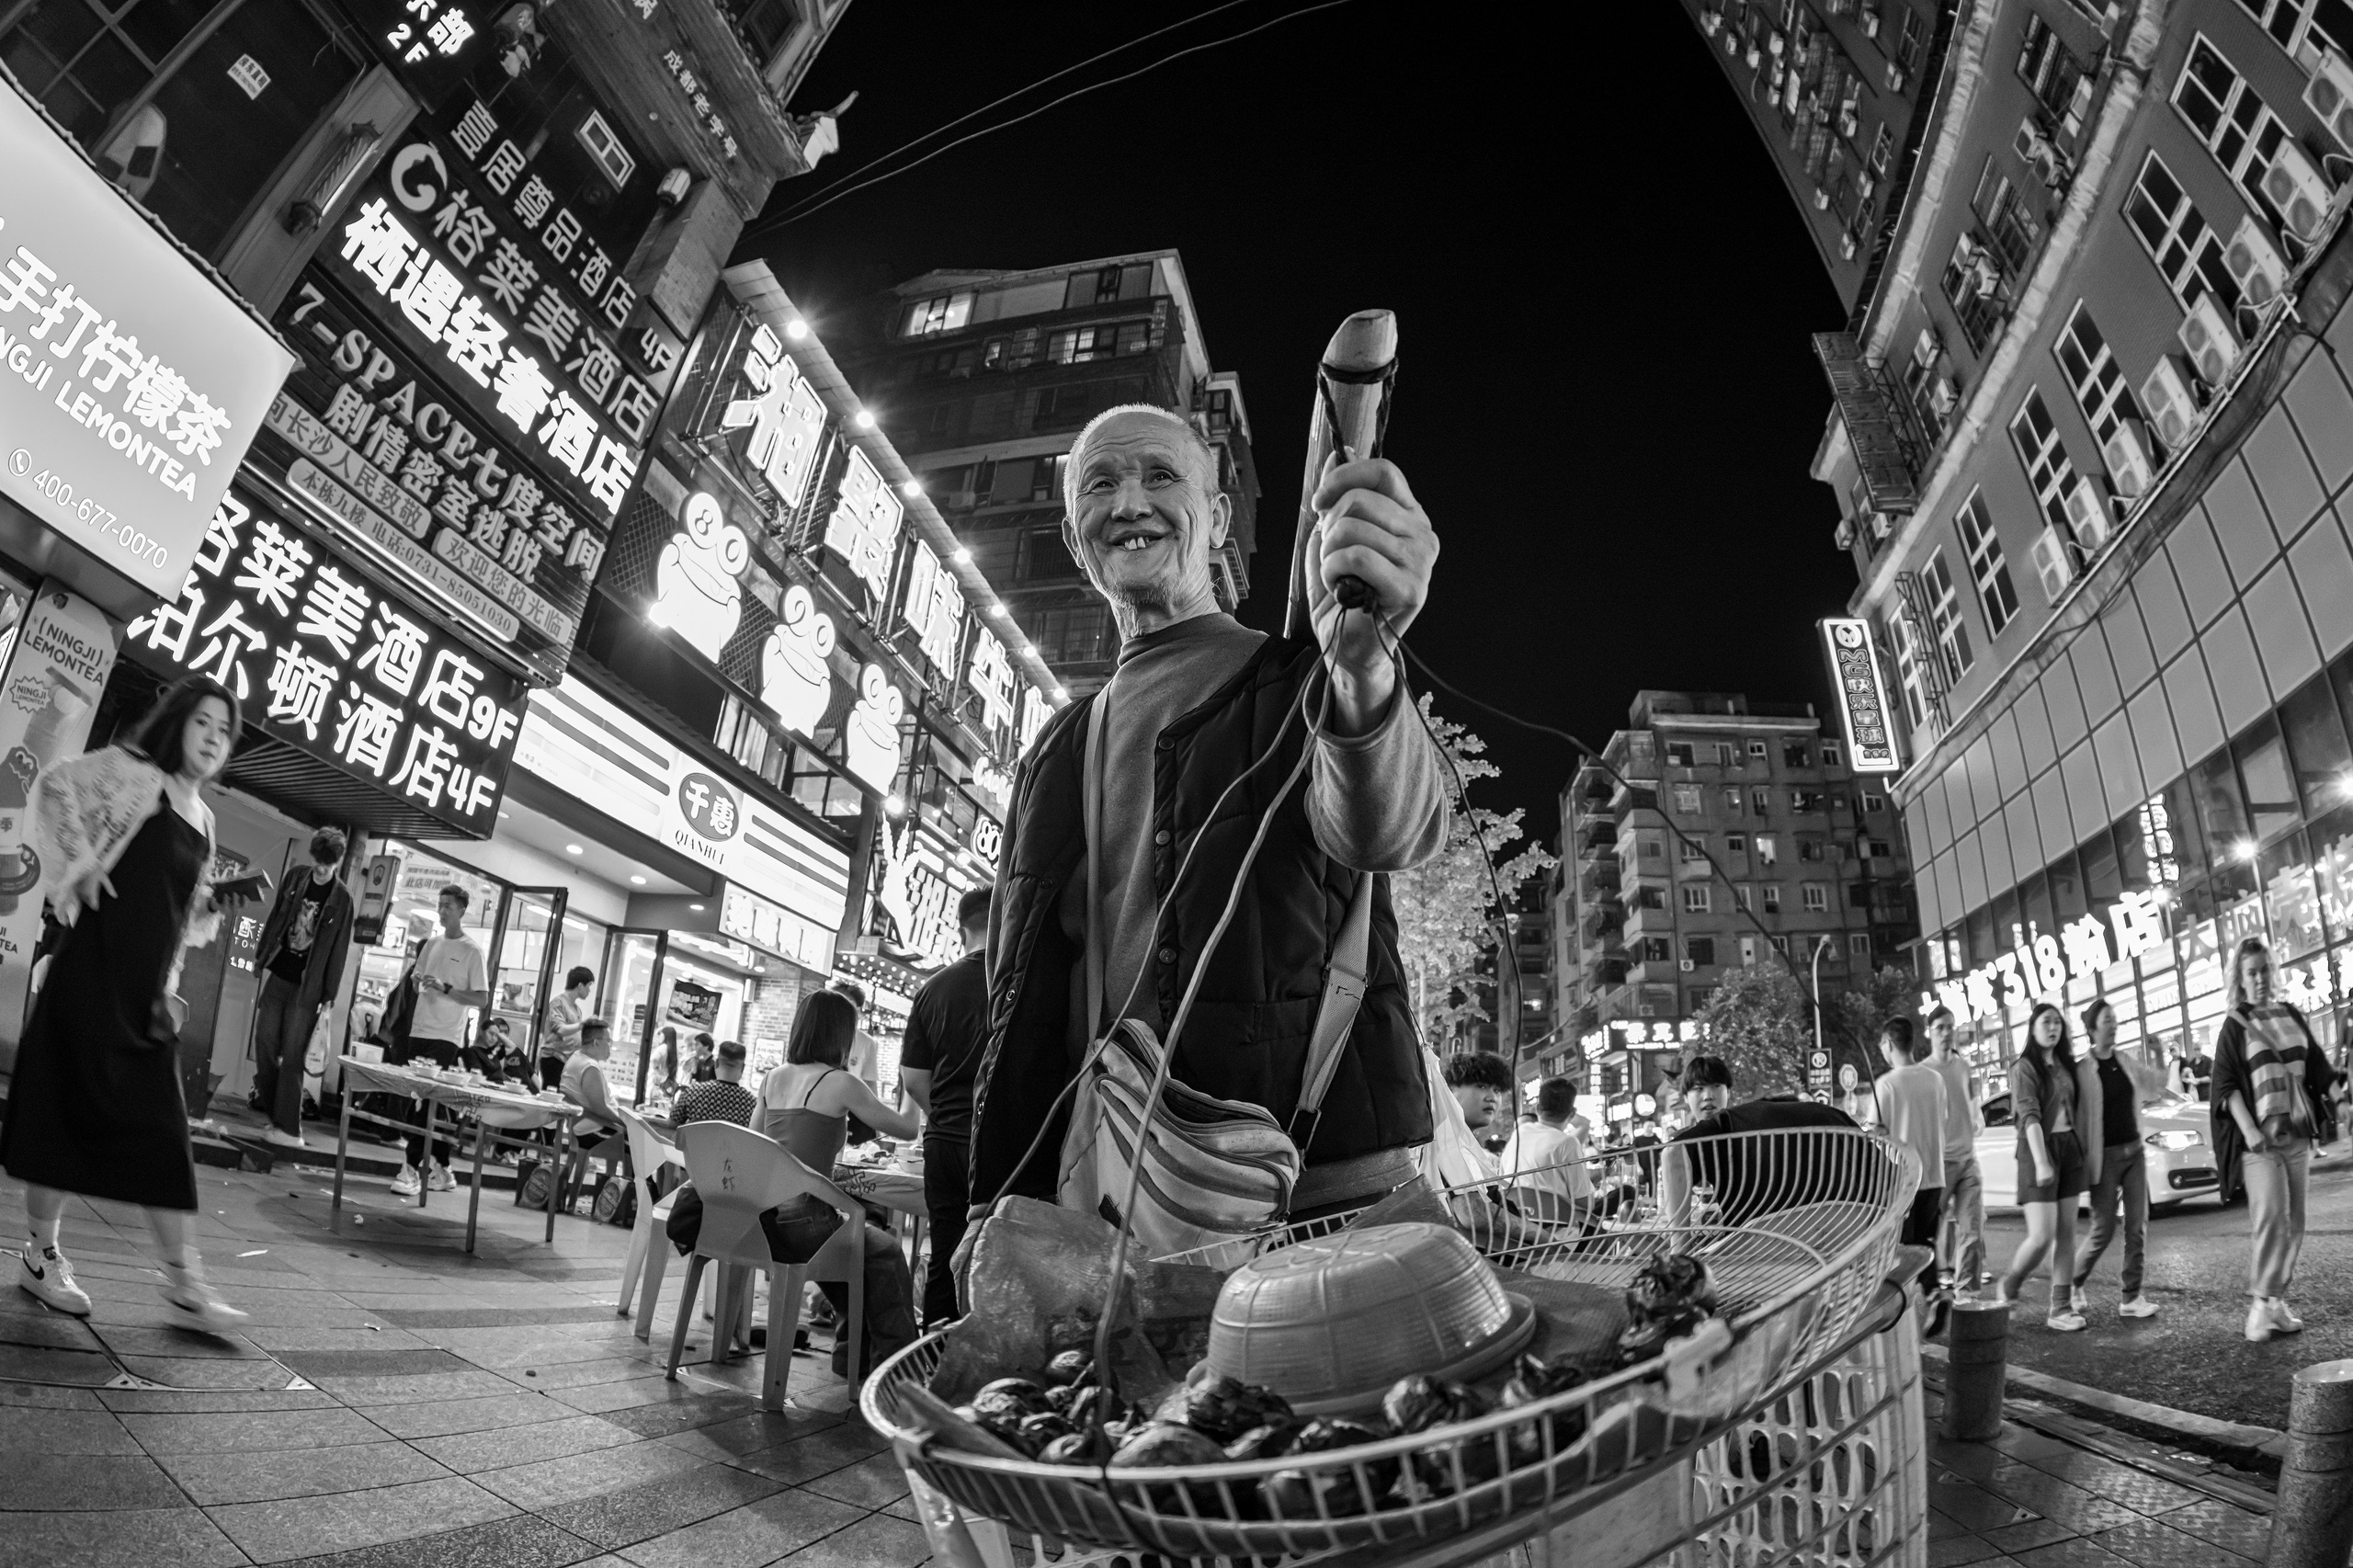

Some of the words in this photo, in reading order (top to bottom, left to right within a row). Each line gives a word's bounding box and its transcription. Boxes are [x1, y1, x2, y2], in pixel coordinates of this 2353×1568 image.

[387, 23, 430, 63] 2F
[664, 50, 737, 158] 成都老字号
[0, 244, 232, 466] 手打柠檬茶
[341, 197, 639, 515] 栖遇轻奢酒店
[434, 188, 658, 443] 格莱美酒店
[641, 327, 673, 369] 4F
[54, 380, 197, 502] LEMONTEA
[322, 382, 542, 585] 剧情密室逃脱
[33, 469, 168, 569] 400-677-0070
[449, 536, 564, 640] 欢迎您的光临
[17, 685, 47, 699] NINGJI
[24, 630, 102, 687] LEMONTEA
[675, 829, 725, 866] QIANHUI
[684, 779, 735, 837] 千惠
